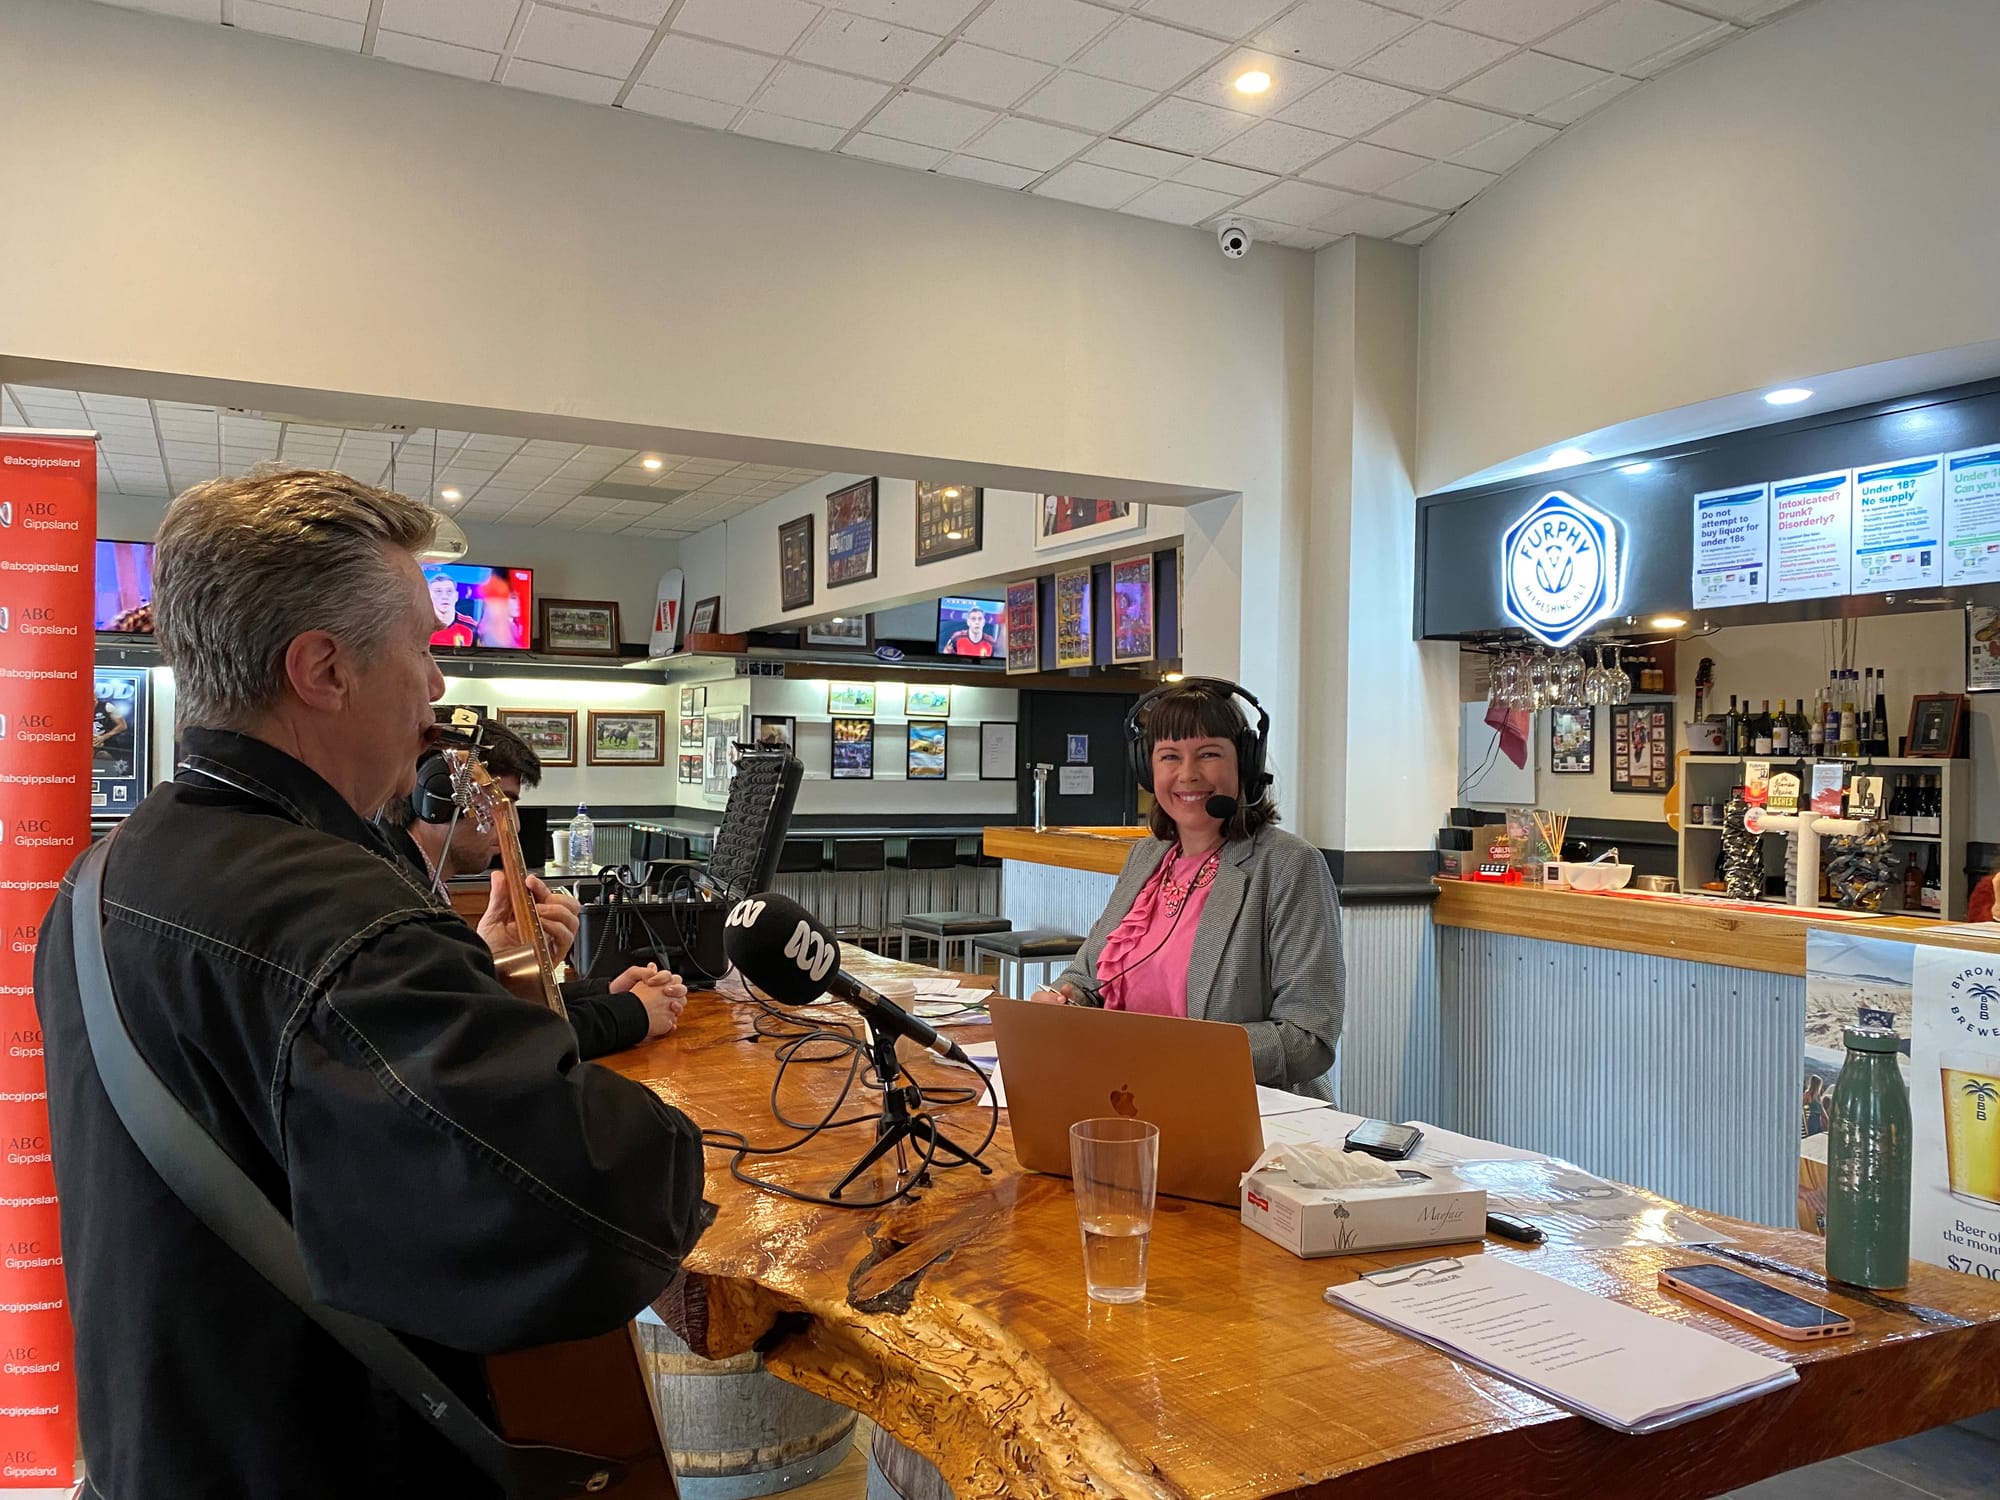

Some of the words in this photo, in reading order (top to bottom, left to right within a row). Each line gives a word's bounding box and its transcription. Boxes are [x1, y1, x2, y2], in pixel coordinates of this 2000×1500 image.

[4, 455, 80, 468] @abcgippsland
[1955, 472, 1988, 483] Under
[1862, 484, 1894, 496] Under
[1897, 479, 1916, 490] 18?
[1954, 484, 1974, 494] Can
[1976, 482, 1996, 493] you
[1779, 492, 1841, 509] Intoxicated?
[1861, 497, 1876, 506] No
[24, 503, 57, 515] ABC
[1702, 511, 1713, 519] Do
[1716, 509, 1731, 517] not
[1779, 507, 1813, 520] Drunk?
[23, 518, 78, 531] Gippsland
[1701, 517, 1737, 529] attempt
[1779, 514, 1835, 530] Disorderly?
[1701, 530, 1717, 539] buy
[1719, 526, 1744, 536] liquor
[1747, 523, 1759, 531] for
[1520, 521, 1590, 560] FURPHY
[1701, 537, 1727, 547] under
[1730, 535, 1745, 543] 18s
[1, 561, 78, 573] @abcgippsland
[21, 608, 55, 620] ABC
[20, 624, 77, 635] Gippsland
[95, 683, 134, 699] DD
[18, 715, 54, 728] ABC
[17, 730, 76, 742] Gippsland
[1770, 797, 1793, 806] LASHES
[16, 820, 51, 832] ABC
[15, 836, 74, 847] Gippsland
[0, 880, 59, 891] abcgippsla
[13, 926, 37, 938] AB
[1952, 967, 1994, 989] BYRON
[1951, 1006, 2000, 1037] BREWE
[10, 1047, 44, 1058] Gipps
[8, 1137, 44, 1149] ABC
[7, 1153, 52, 1164] Gippsla
[0, 1196, 58, 1207] bcgippslan
[1956, 1219, 1987, 1238] Beer
[6, 1242, 40, 1254] ABC
[1943, 1230, 1964, 1245] the
[1967, 1239, 2000, 1255] mon
[5, 1256, 63, 1269] Gippsland
[0, 1300, 62, 1312] bcgippsland
[5, 1347, 39, 1360] ABC
[4, 1362, 60, 1375] Gippsland
[4, 1451, 37, 1463] ABC
[3, 1467, 57, 1477] Gippsland
